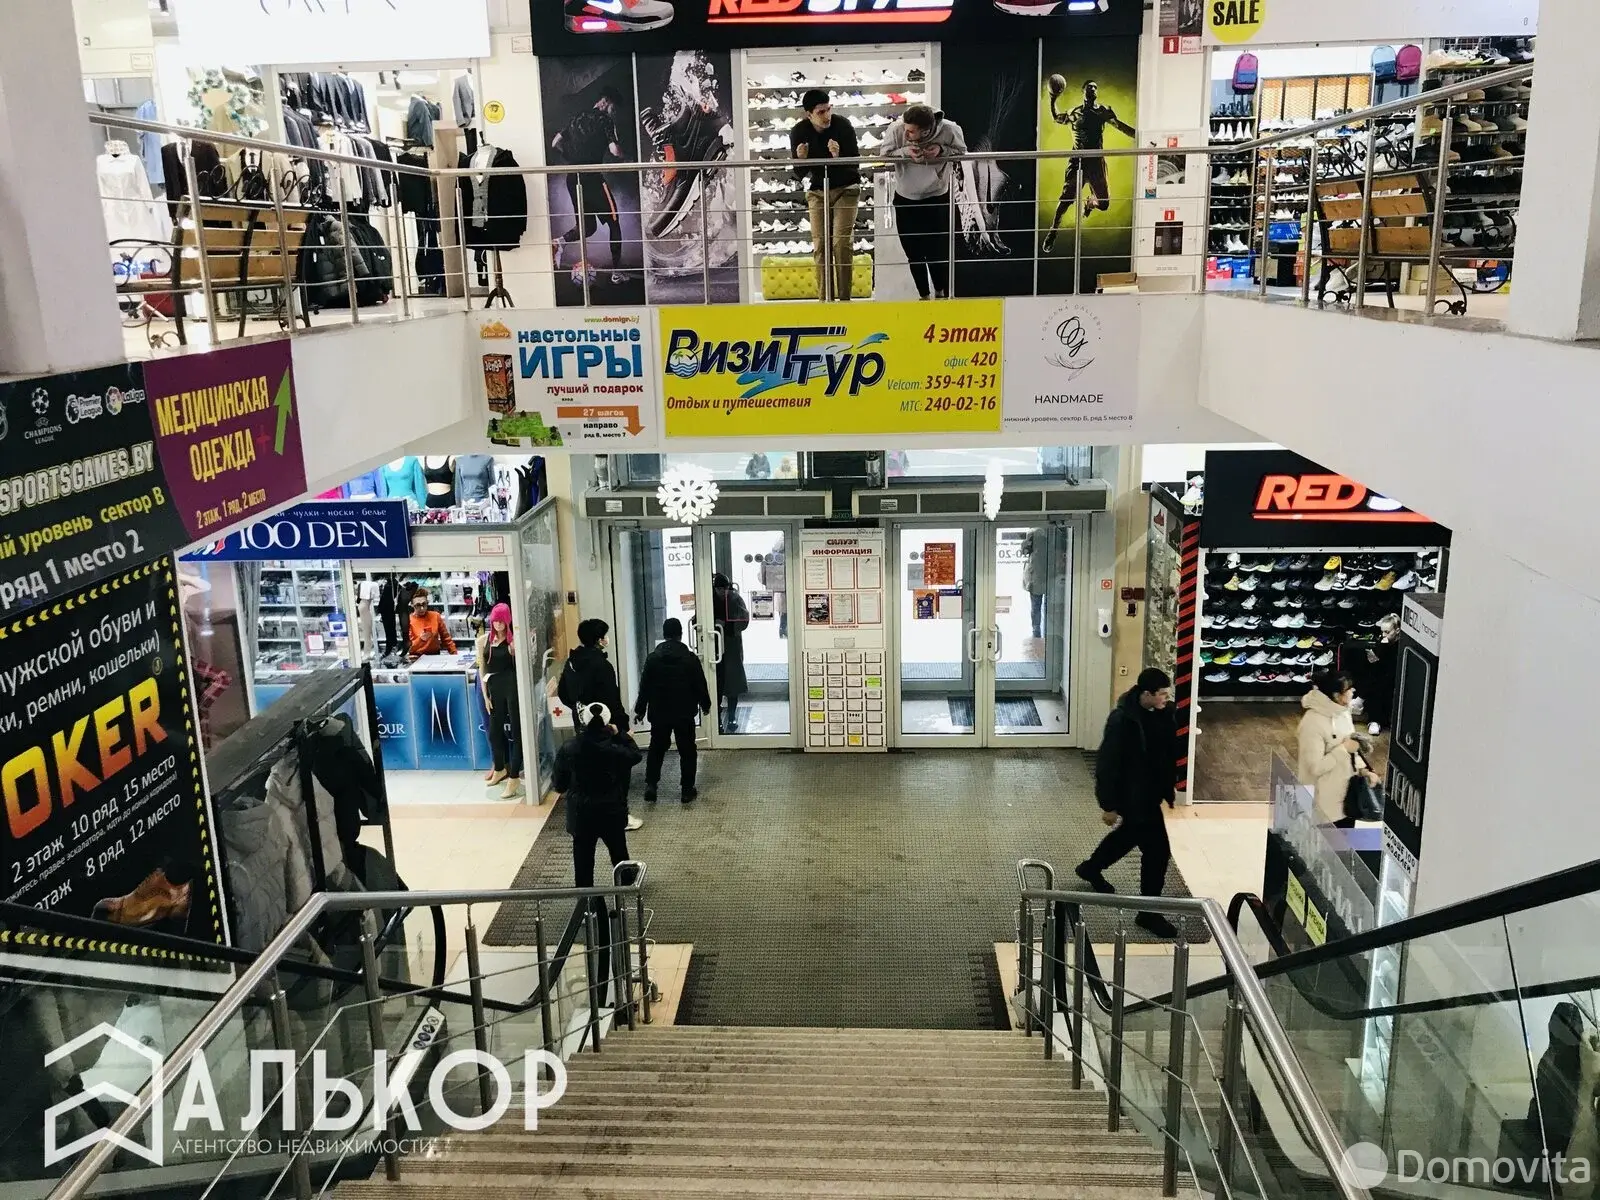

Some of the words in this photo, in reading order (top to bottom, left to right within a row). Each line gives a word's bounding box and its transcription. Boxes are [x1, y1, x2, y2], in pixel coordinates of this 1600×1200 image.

[1213, 0, 1259, 26] SALE
[518, 328, 641, 343] настольные
[923, 324, 935, 343] 4
[939, 326, 998, 343] этаж
[519, 344, 643, 379] ИГРЫ
[944, 356, 968, 370] офис
[970, 351, 998, 367] 420
[547, 384, 589, 396] лучший
[593, 384, 644, 396] подарок
[887, 379, 923, 391] Velcom:
[925, 373, 996, 390] 359-41-31
[156, 375, 270, 437] МЕДИЦИНСКАЯ
[667, 396, 710, 410] Отдых
[712, 398, 720, 408] и
[722, 396, 812, 412] путешествия
[924, 396, 996, 411] 240-02-16
[1034, 394, 1104, 404] HANDMADE
[583, 408, 595, 416] 27
[597, 409, 624, 417] шагов
[24, 424, 63, 439] CHAMPIONS
[189, 428, 257, 483] ОДЕЖДА
[0, 441, 154, 516] SPORTSGAMES.BY
[1255, 474, 1367, 511] RED
[196, 510, 204, 529] 2
[222, 499, 228, 518] 1
[242, 491, 249, 510] 2
[293, 510, 319, 518] чулки
[362, 508, 387, 516] белье
[19, 515, 94, 556] уровень
[100, 494, 152, 523] сектор
[239, 520, 300, 550] 100
[307, 520, 388, 549] DEN
[812, 548, 873, 556] ИНФОРМАЦИЯ
[0, 571, 48, 610] ряд
[45, 558, 61, 585] 1
[62, 541, 126, 579] место
[125, 529, 145, 555] 2
[89, 608, 142, 649] обуви
[146, 600, 156, 620] и
[26, 677, 86, 724] ремни,
[89, 629, 160, 685] кошельки)
[11, 861, 23, 883] 2
[26, 835, 65, 873] этаж
[71, 814, 89, 841] 10
[92, 797, 119, 829] ряд
[123, 777, 139, 802] 15
[142, 755, 175, 789] место
[86, 857, 96, 878] 8
[98, 839, 126, 873] ряд
[129, 819, 146, 844] 12
[147, 794, 181, 830] место
[39, 856, 65, 880] правее
